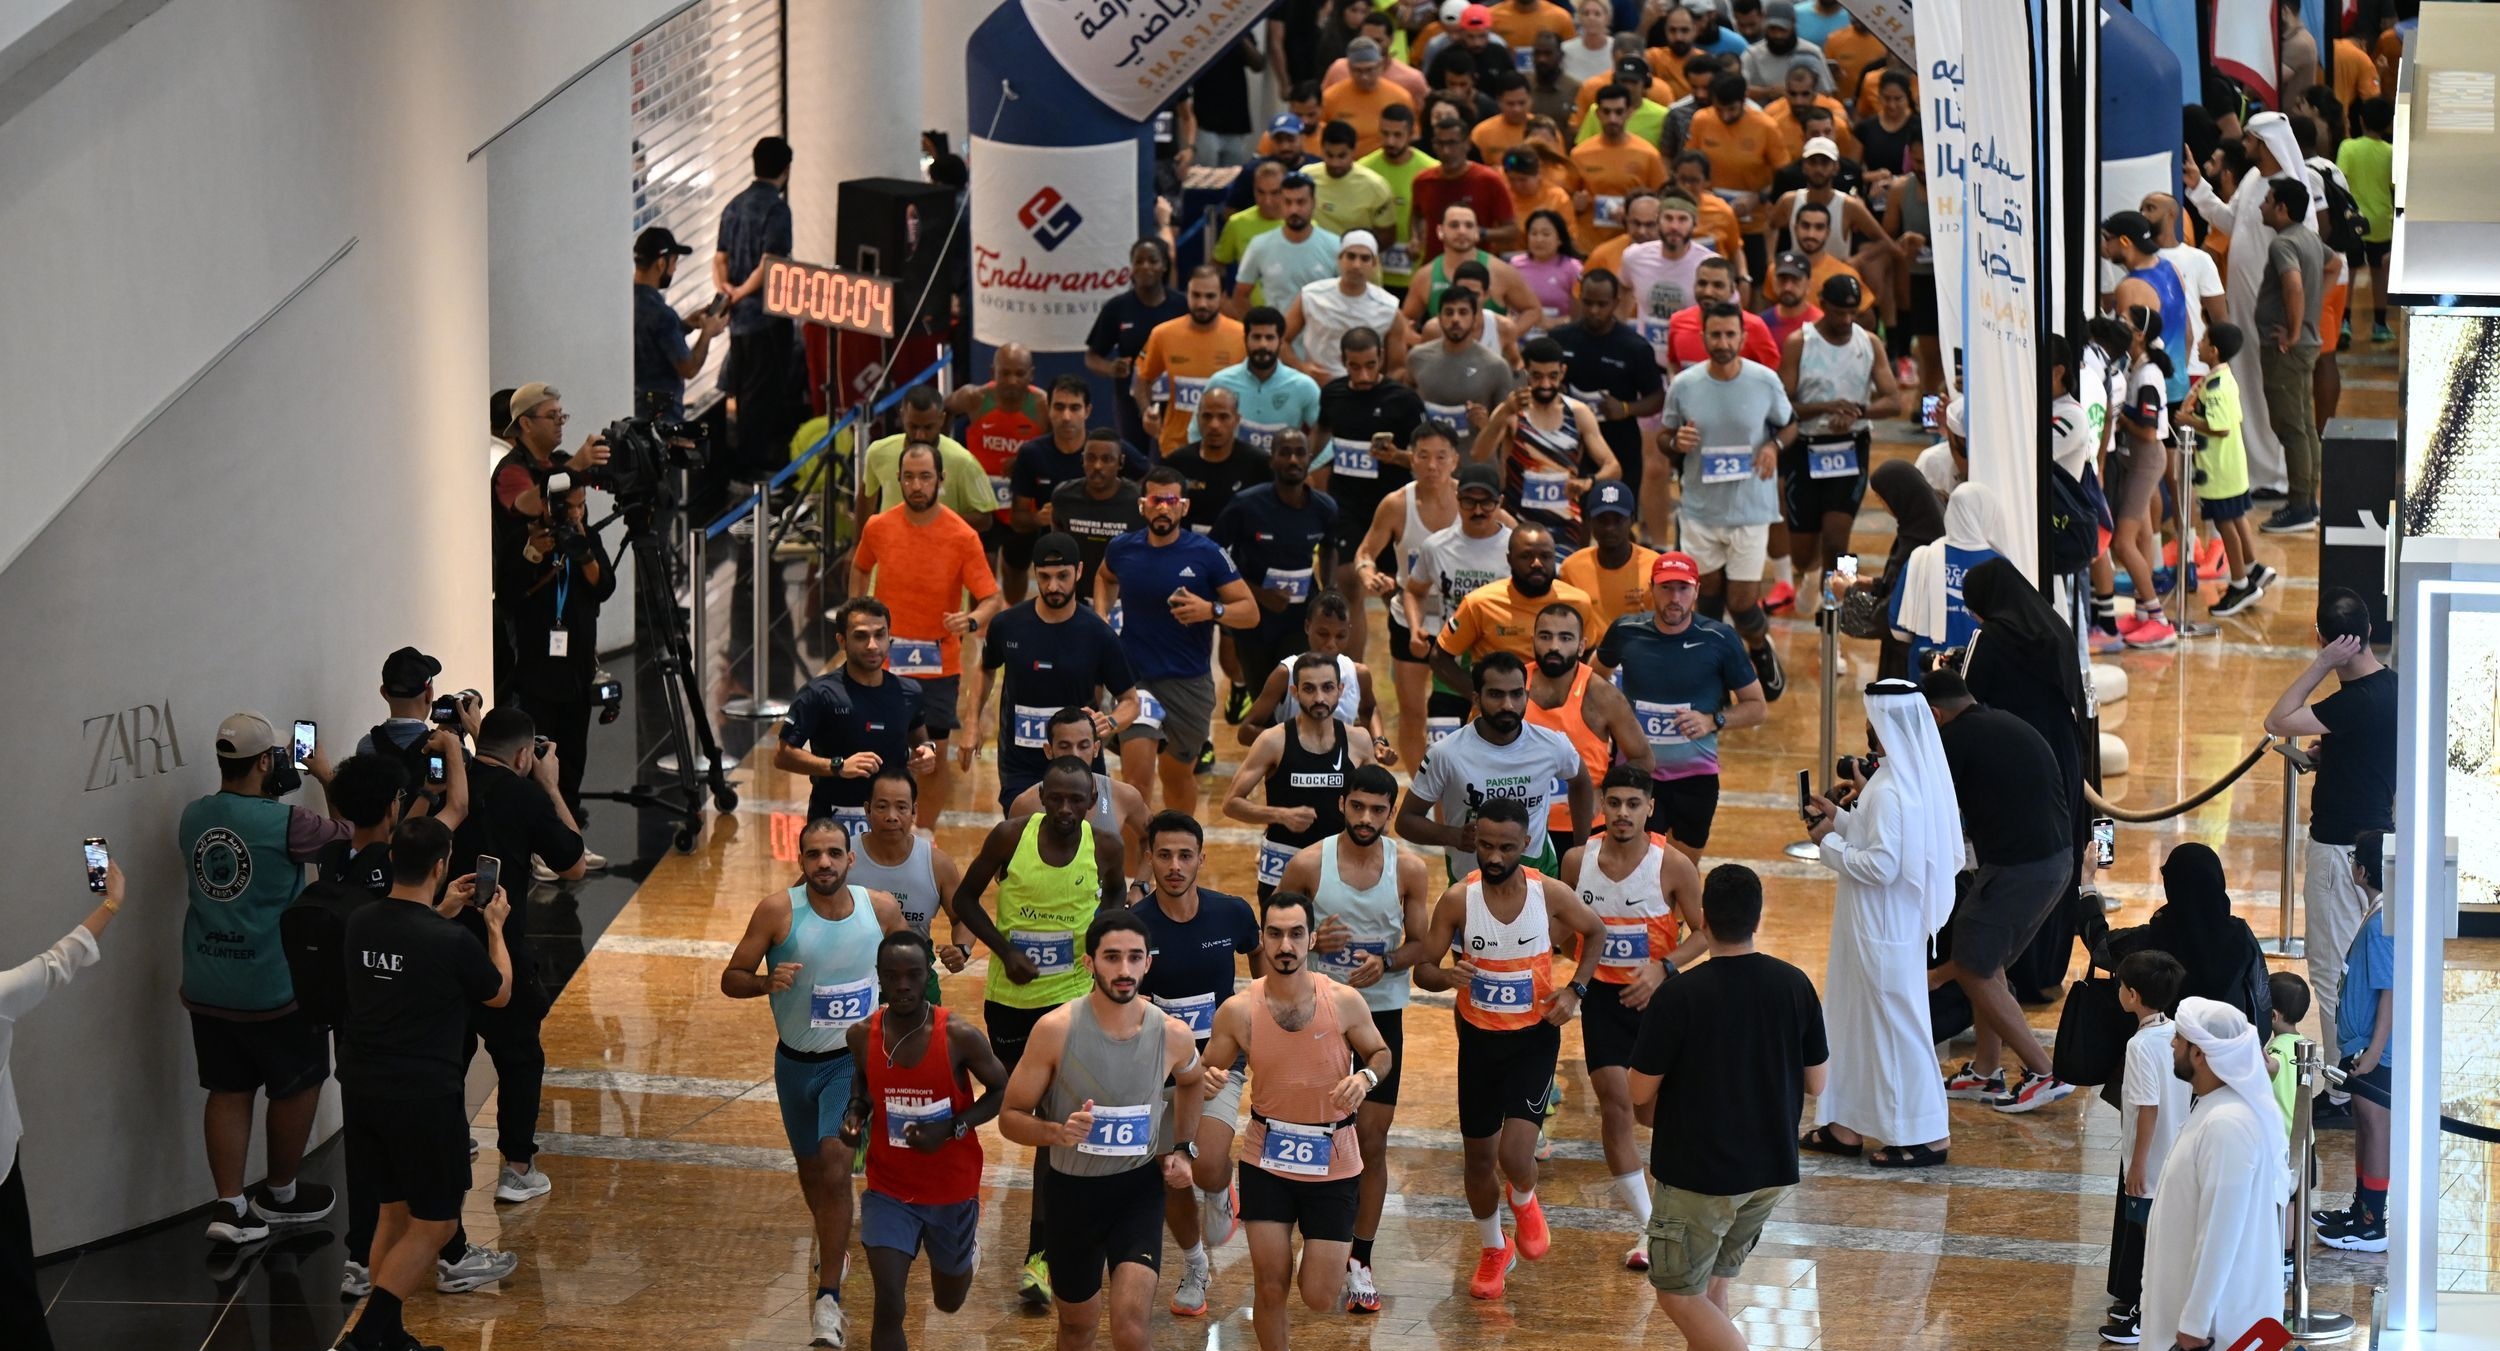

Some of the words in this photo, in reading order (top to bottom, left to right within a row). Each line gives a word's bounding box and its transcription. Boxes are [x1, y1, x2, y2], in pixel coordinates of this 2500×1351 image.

[975, 244, 1133, 293] Endurance
[768, 263, 892, 333] 00:00:04
[1043, 300, 1101, 316] SERVI
[983, 433, 1025, 453] KENY
[1340, 451, 1373, 469] 115
[1714, 458, 1741, 474] 23
[1821, 454, 1846, 471] 90
[1535, 485, 1560, 500] 10
[1070, 519, 1101, 528] WINNERS
[1103, 522, 1128, 530] NEVER
[1071, 526, 1090, 535] MAKE
[1455, 570, 1496, 579] PAKISTAN
[1007, 641, 1019, 649] UAE
[907, 648, 922, 665] 4
[834, 707, 850, 715] UAE
[1648, 717, 1677, 735] 62
[82, 697, 188, 793] ZARA
[1292, 775, 1326, 785] BLOCK
[1486, 776, 1531, 787] PAKISTAN
[1486, 786, 1526, 800] ROAD
[1038, 912, 1055, 920] NEW
[196, 943, 256, 960] VOLUNTEER
[1025, 946, 1057, 965] 65
[1605, 939, 1633, 957] 79
[362, 950, 403, 972] UAE
[1483, 984, 1516, 1003] 78
[828, 998, 860, 1018] 82
[1100, 1123, 1134, 1144] 16
[1278, 1139, 1313, 1163] 26
